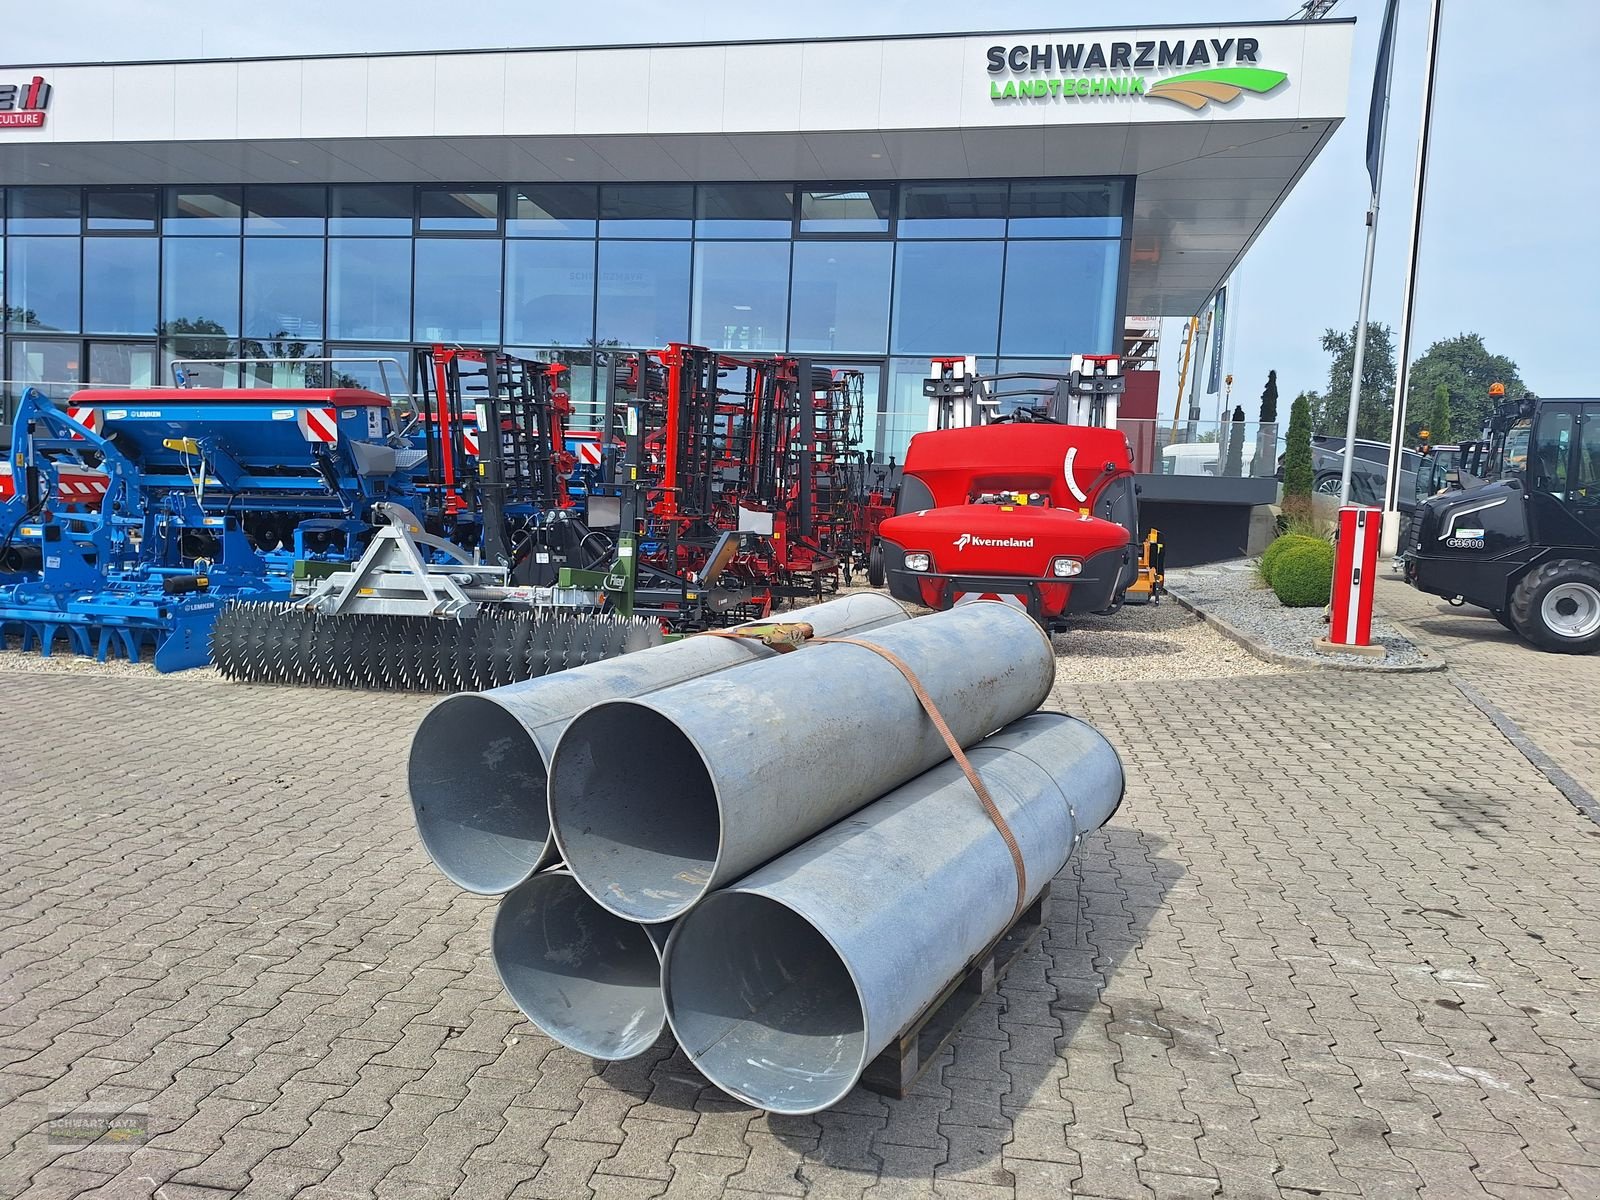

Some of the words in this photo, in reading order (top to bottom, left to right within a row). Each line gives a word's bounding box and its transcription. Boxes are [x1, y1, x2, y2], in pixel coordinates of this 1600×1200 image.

[987, 37, 1260, 73] SCHWARZMAYR
[990, 77, 1145, 100] LANDTECHNIK
[971, 536, 1034, 548] Kverneland
[1446, 537, 1485, 549] G3500
[190, 602, 215, 611] LEMKEN
